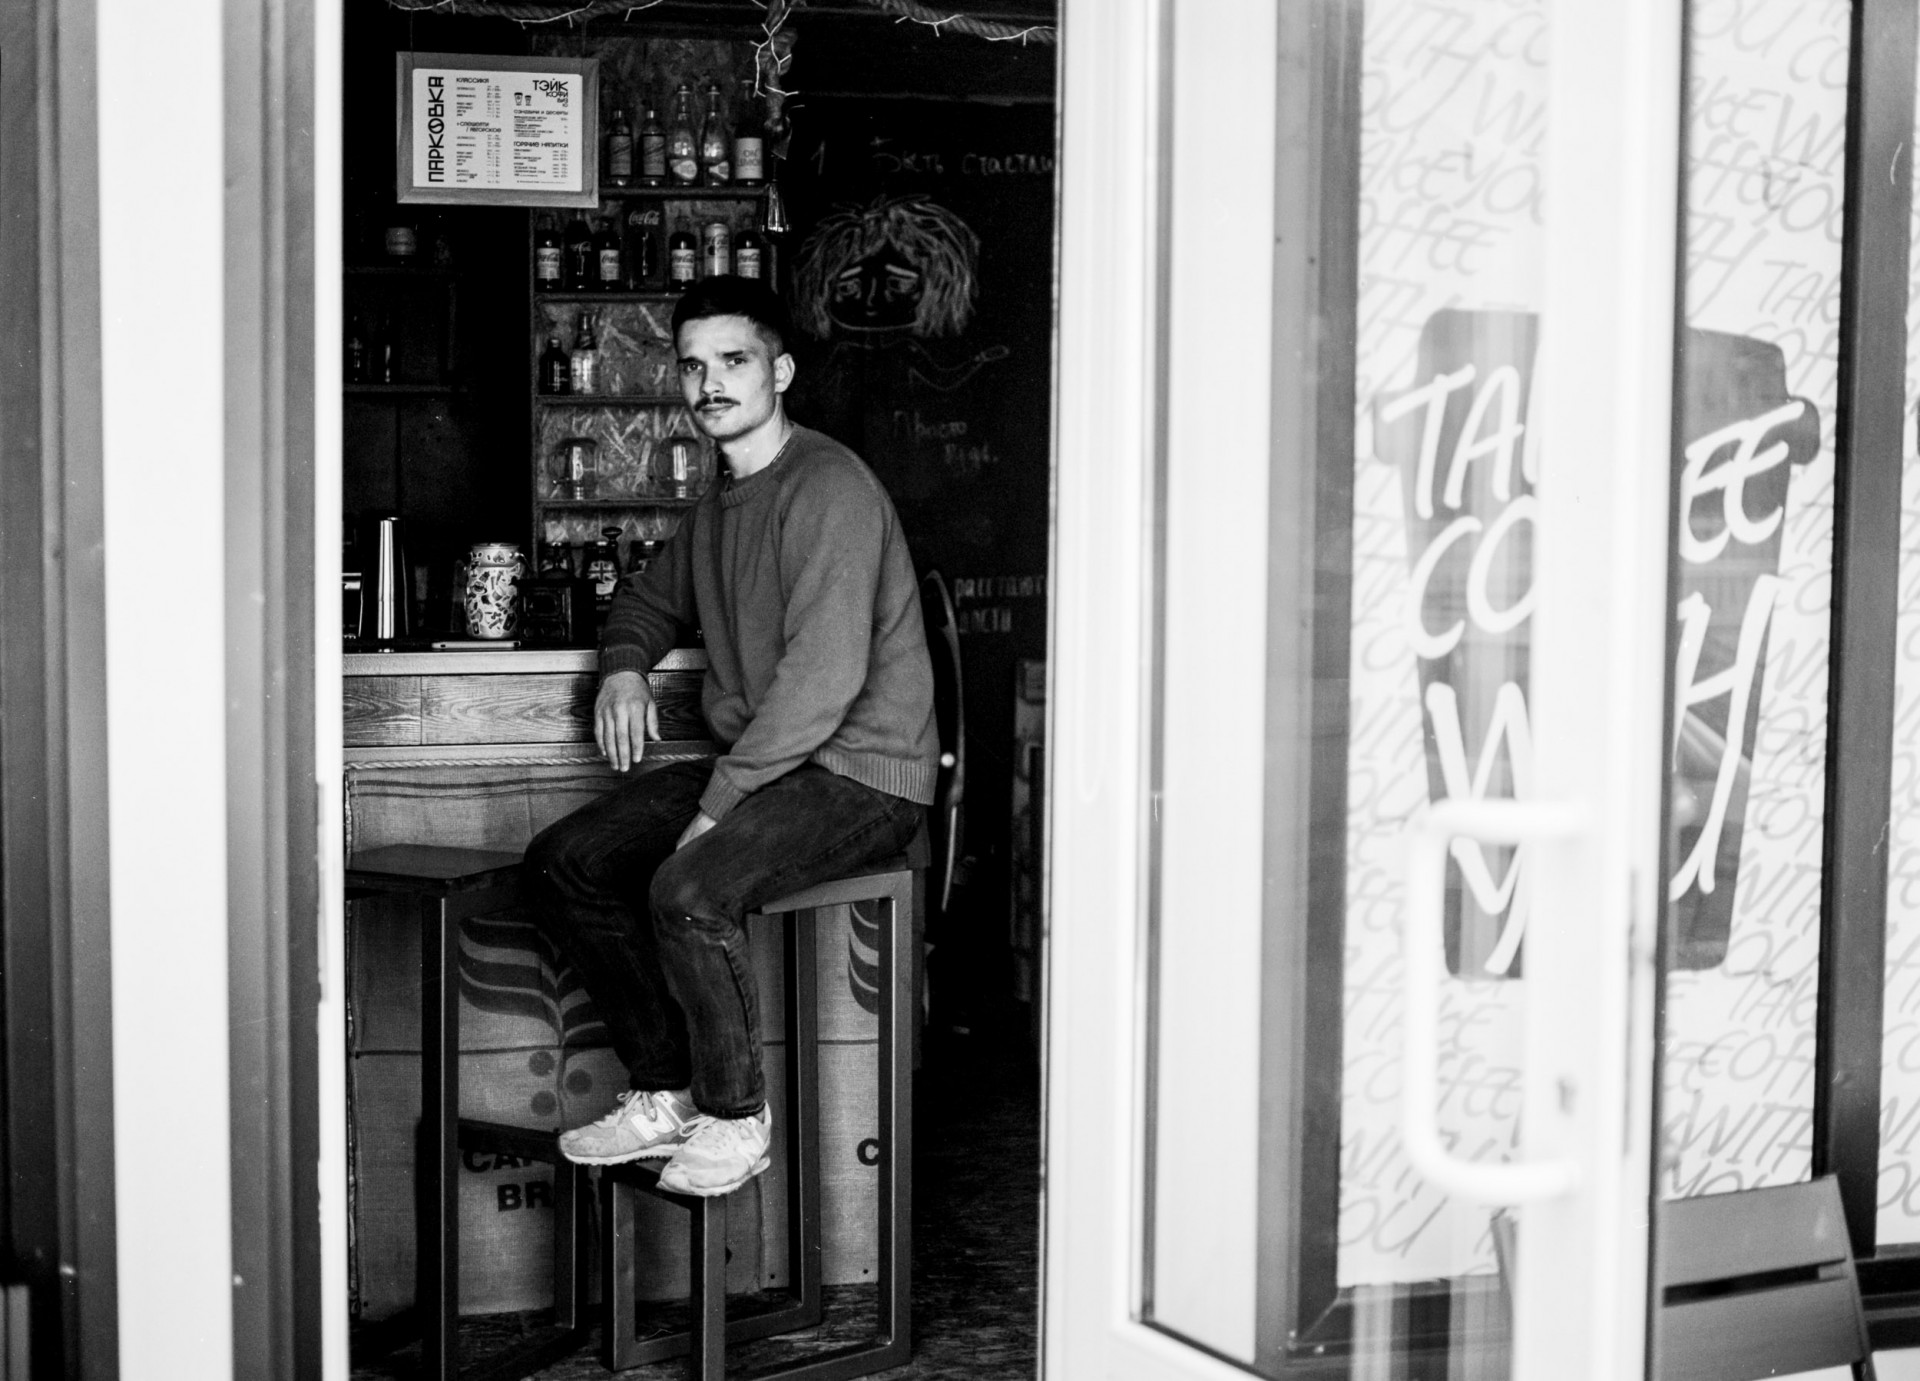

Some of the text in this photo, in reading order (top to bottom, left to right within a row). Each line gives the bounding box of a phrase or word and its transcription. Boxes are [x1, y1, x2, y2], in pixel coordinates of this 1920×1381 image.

[428, 76, 444, 182] ПАРКОВКА
[532, 77, 568, 92] ТЭЙК
[1381, 362, 1541, 521] TA
